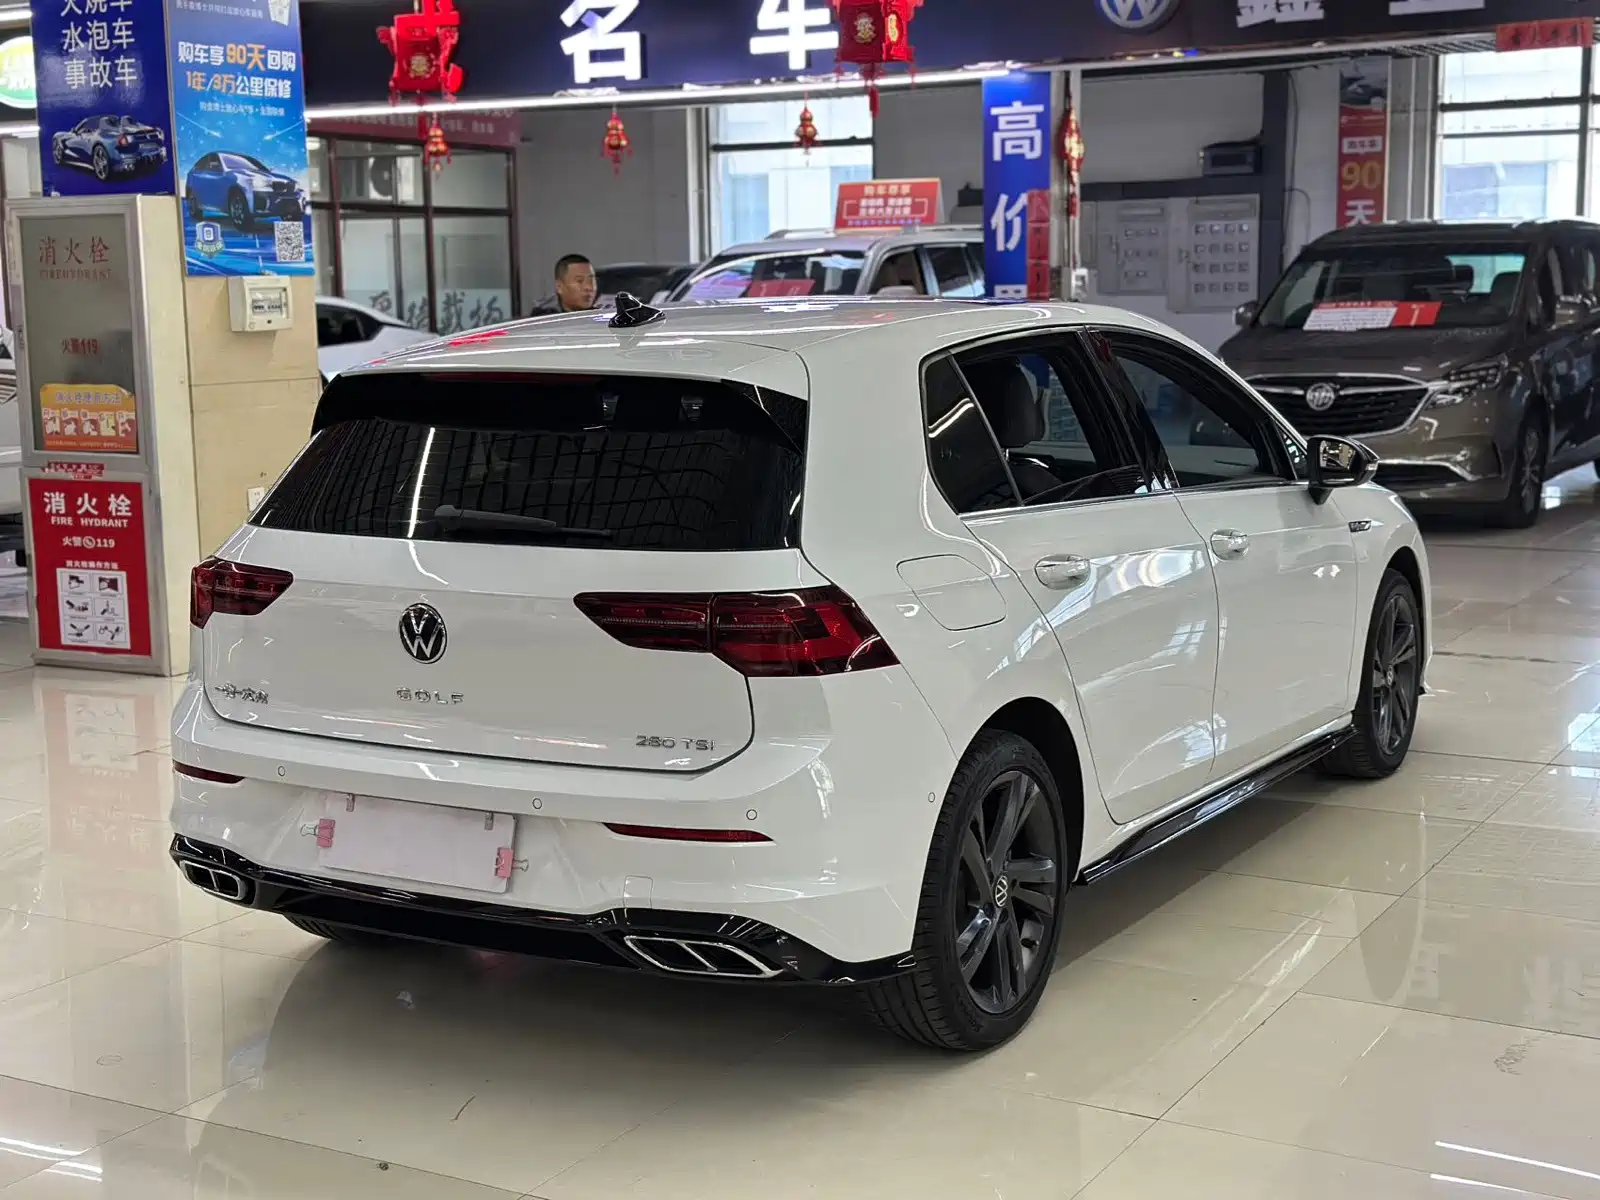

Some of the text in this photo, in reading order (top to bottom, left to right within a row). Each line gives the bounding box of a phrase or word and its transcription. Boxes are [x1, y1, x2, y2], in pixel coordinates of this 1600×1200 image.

[61, 17, 135, 53] 水泡车
[178, 41, 297, 72] 购车享90天回购
[63, 55, 138, 89] 事故车
[186, 70, 292, 98] 1年/3万公里保修
[1341, 160, 1382, 191] 90
[1344, 198, 1376, 227] 天
[39, 236, 111, 266] 消火栓
[43, 491, 133, 517] 消火栓
[51, 516, 129, 529] FIRE HYDRANT
[62, 535, 116, 549] 火警 119
[396, 686, 465, 706] GOLF
[635, 735, 716, 751] 280 TSI
